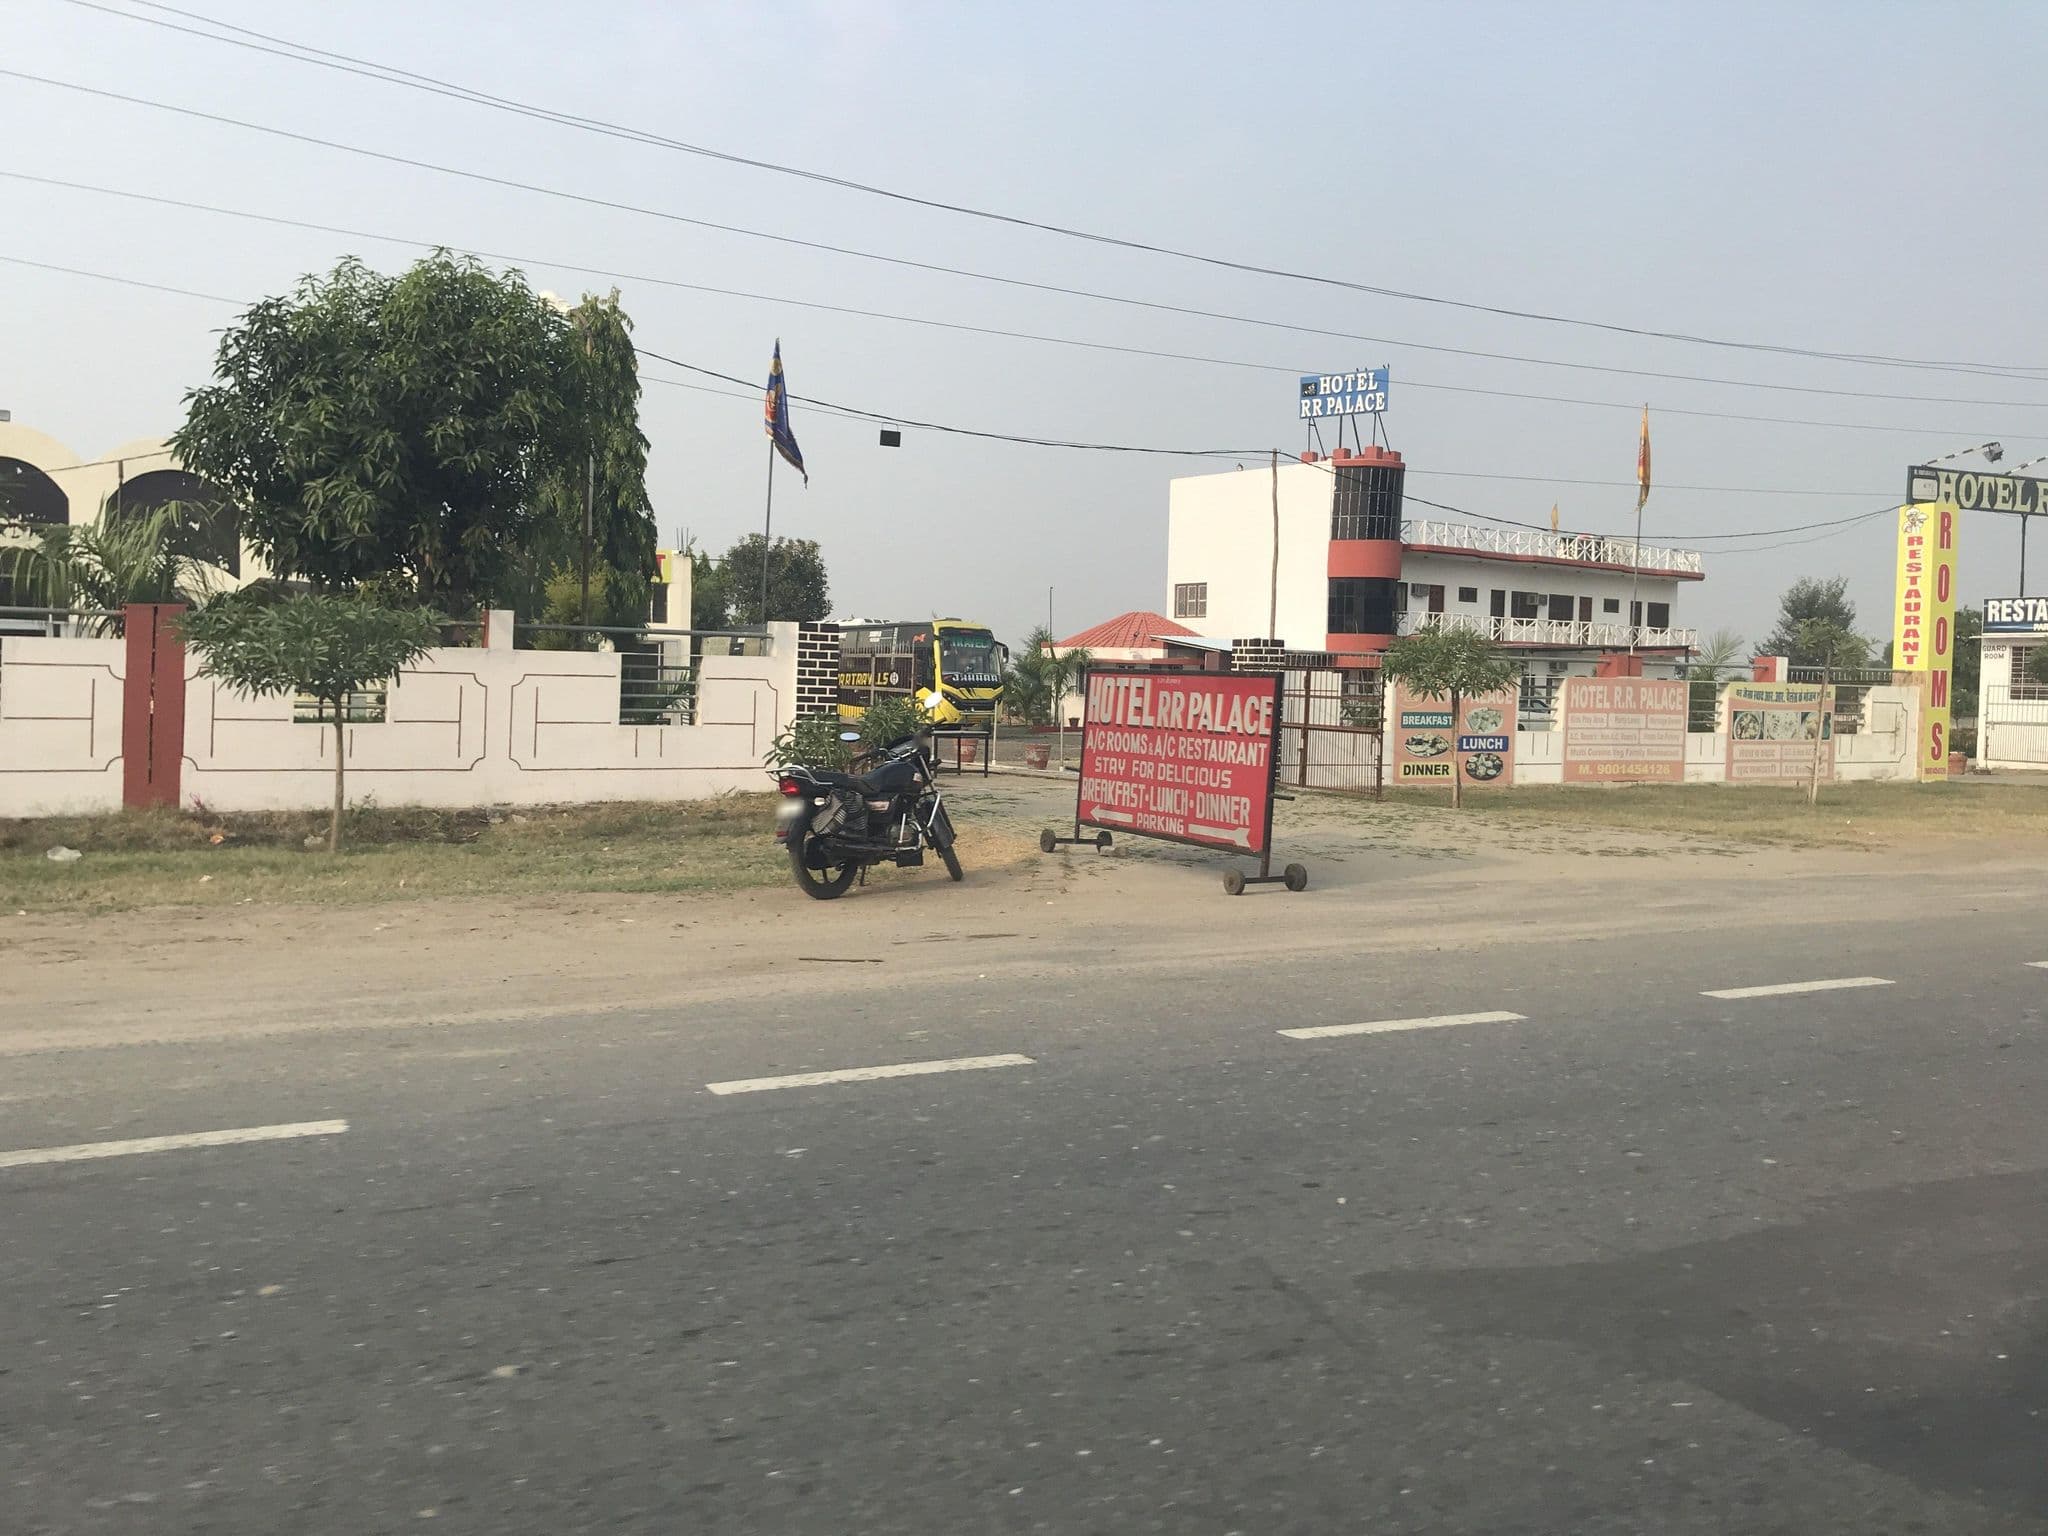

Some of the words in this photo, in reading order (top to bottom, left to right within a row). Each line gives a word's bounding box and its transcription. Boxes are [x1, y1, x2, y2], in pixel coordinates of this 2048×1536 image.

[1319, 372, 1378, 395] HOTEL
[1301, 399, 1323, 418] RR
[1327, 392, 1385, 416] PALACE
[1937, 471, 2032, 513] HOTEL
[1902, 536, 1923, 665] RESTAURANT
[1931, 511, 1951, 760] ROOMS
[1087, 676, 1155, 728] HOTEL
[1157, 690, 1185, 731] RR
[1186, 692, 1274, 736] PALACE
[1570, 685, 1610, 709] HOTEL
[1614, 686, 1636, 709] R.R.
[1640, 687, 1684, 710] PALACE
[1402, 715, 1453, 726] BREAKFAST
[1086, 731, 1105, 753] A/C
[1106, 733, 1148, 755] ROOMS
[1154, 732, 1177, 760] A/C
[1178, 737, 1267, 767] RESTAURANT
[1462, 738, 1503, 750] LUNCH
[1095, 758, 1126, 776] STAY
[1132, 760, 1154, 779] FOR
[1157, 763, 1233, 789] DELICIOUS
[1403, 764, 1450, 776] DINNER
[1081, 777, 1146, 809] BREAKFAST
[1150, 786, 1188, 816] LUNCH
[1196, 791, 1250, 826] DINNER
[1136, 813, 1185, 835] PARKING
